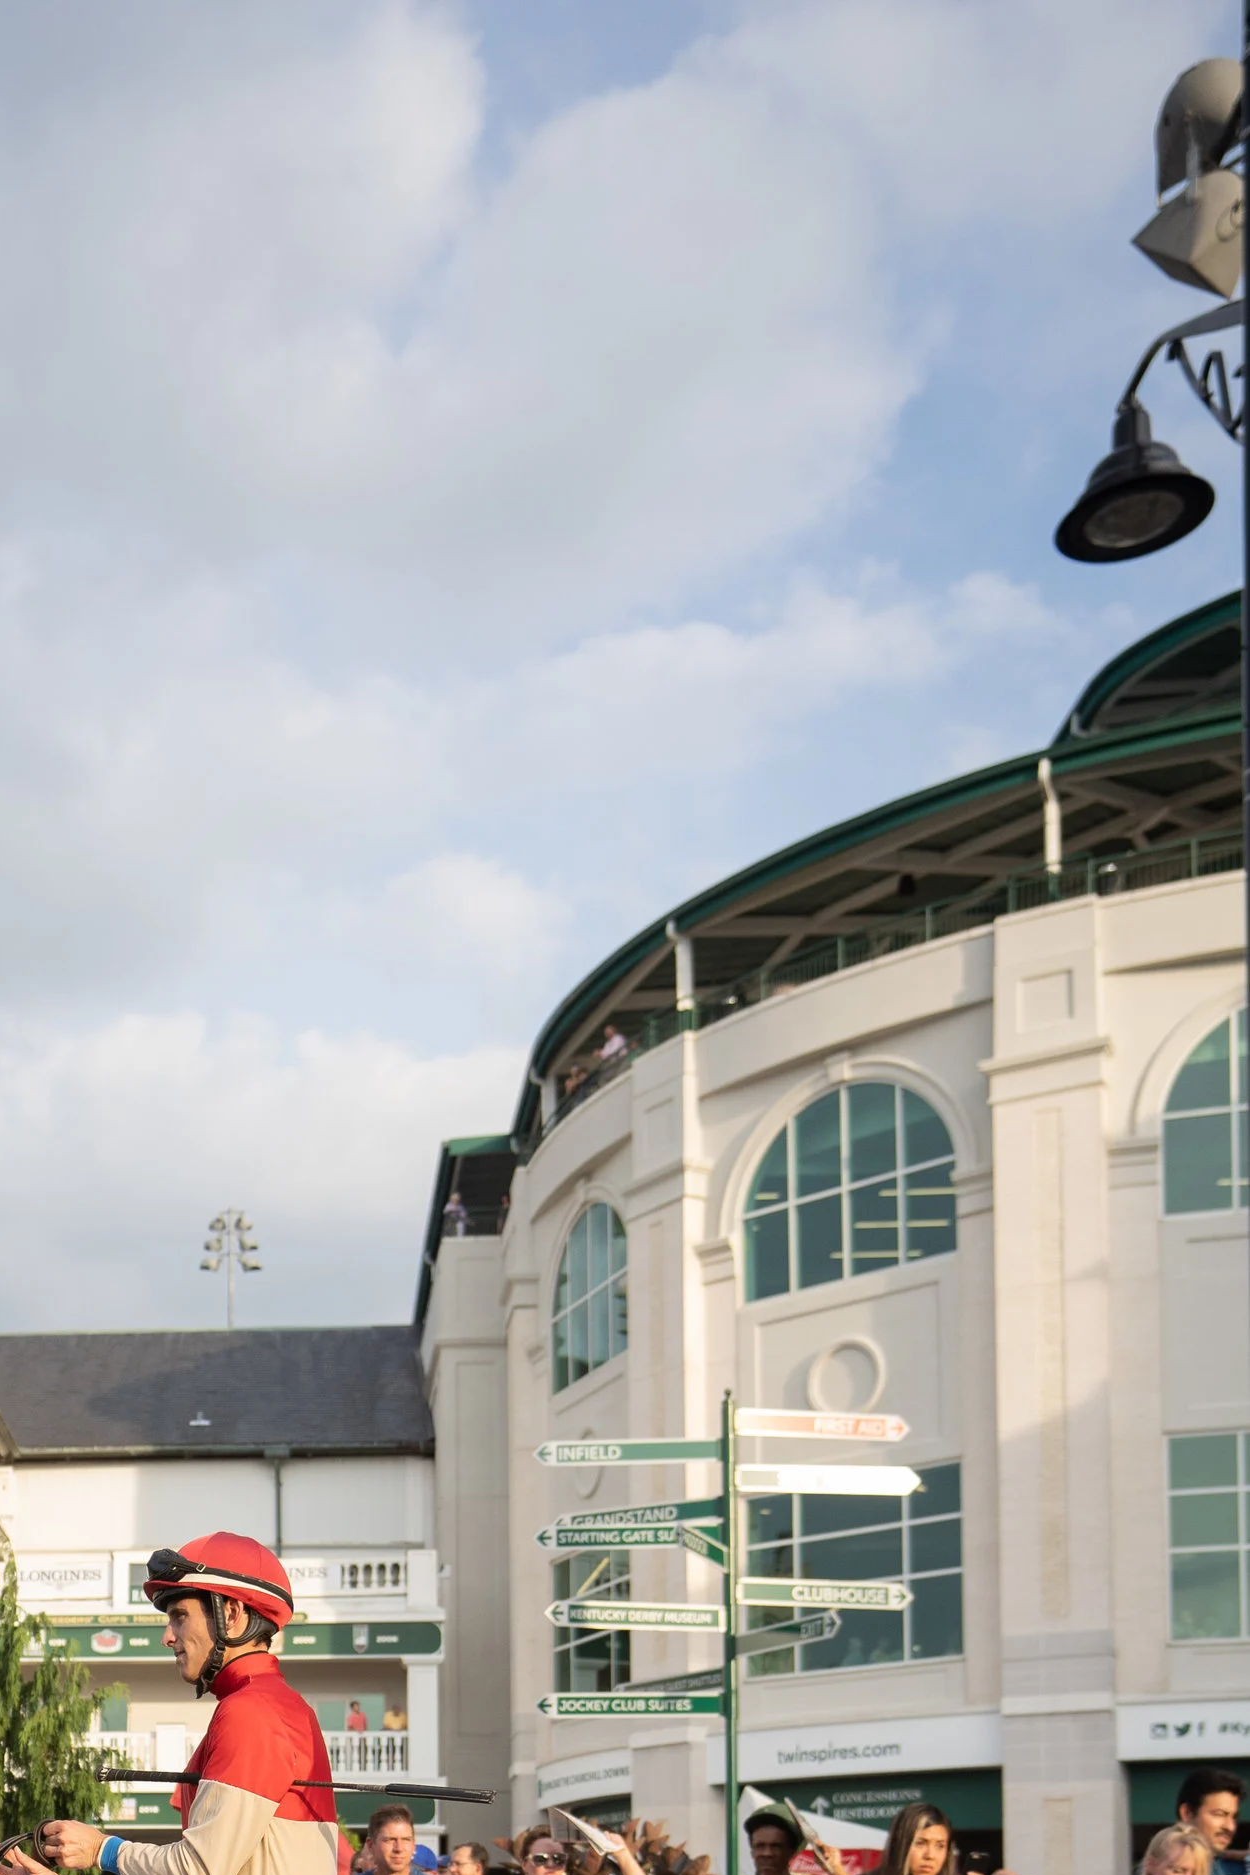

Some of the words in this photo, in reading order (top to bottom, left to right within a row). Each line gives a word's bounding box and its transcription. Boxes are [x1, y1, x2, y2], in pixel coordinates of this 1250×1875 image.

[815, 1417, 856, 1434] FIRST
[858, 1419, 885, 1436] AID
[557, 1445, 622, 1462] INFIELD
[572, 1506, 678, 1526] GRANDSTAND
[559, 1530, 620, 1545] STARTING
[622, 1530, 655, 1543] GATE
[20, 1569, 102, 1581] LONGINES
[792, 1586, 887, 1604] CLUBHOUSE
[570, 1609, 627, 1622] KENTUCKY
[628, 1611, 663, 1623] DERBY
[665, 1612, 712, 1624] MUSEUM
[801, 1620, 823, 1638] EXIT
[559, 1699, 610, 1712] JOCKEY
[611, 1699, 646, 1712] CLUB
[647, 1699, 692, 1712] SUITES
[778, 1740, 901, 1764] twinspires.com
[832, 1789, 923, 1804] CONCESSIONS
